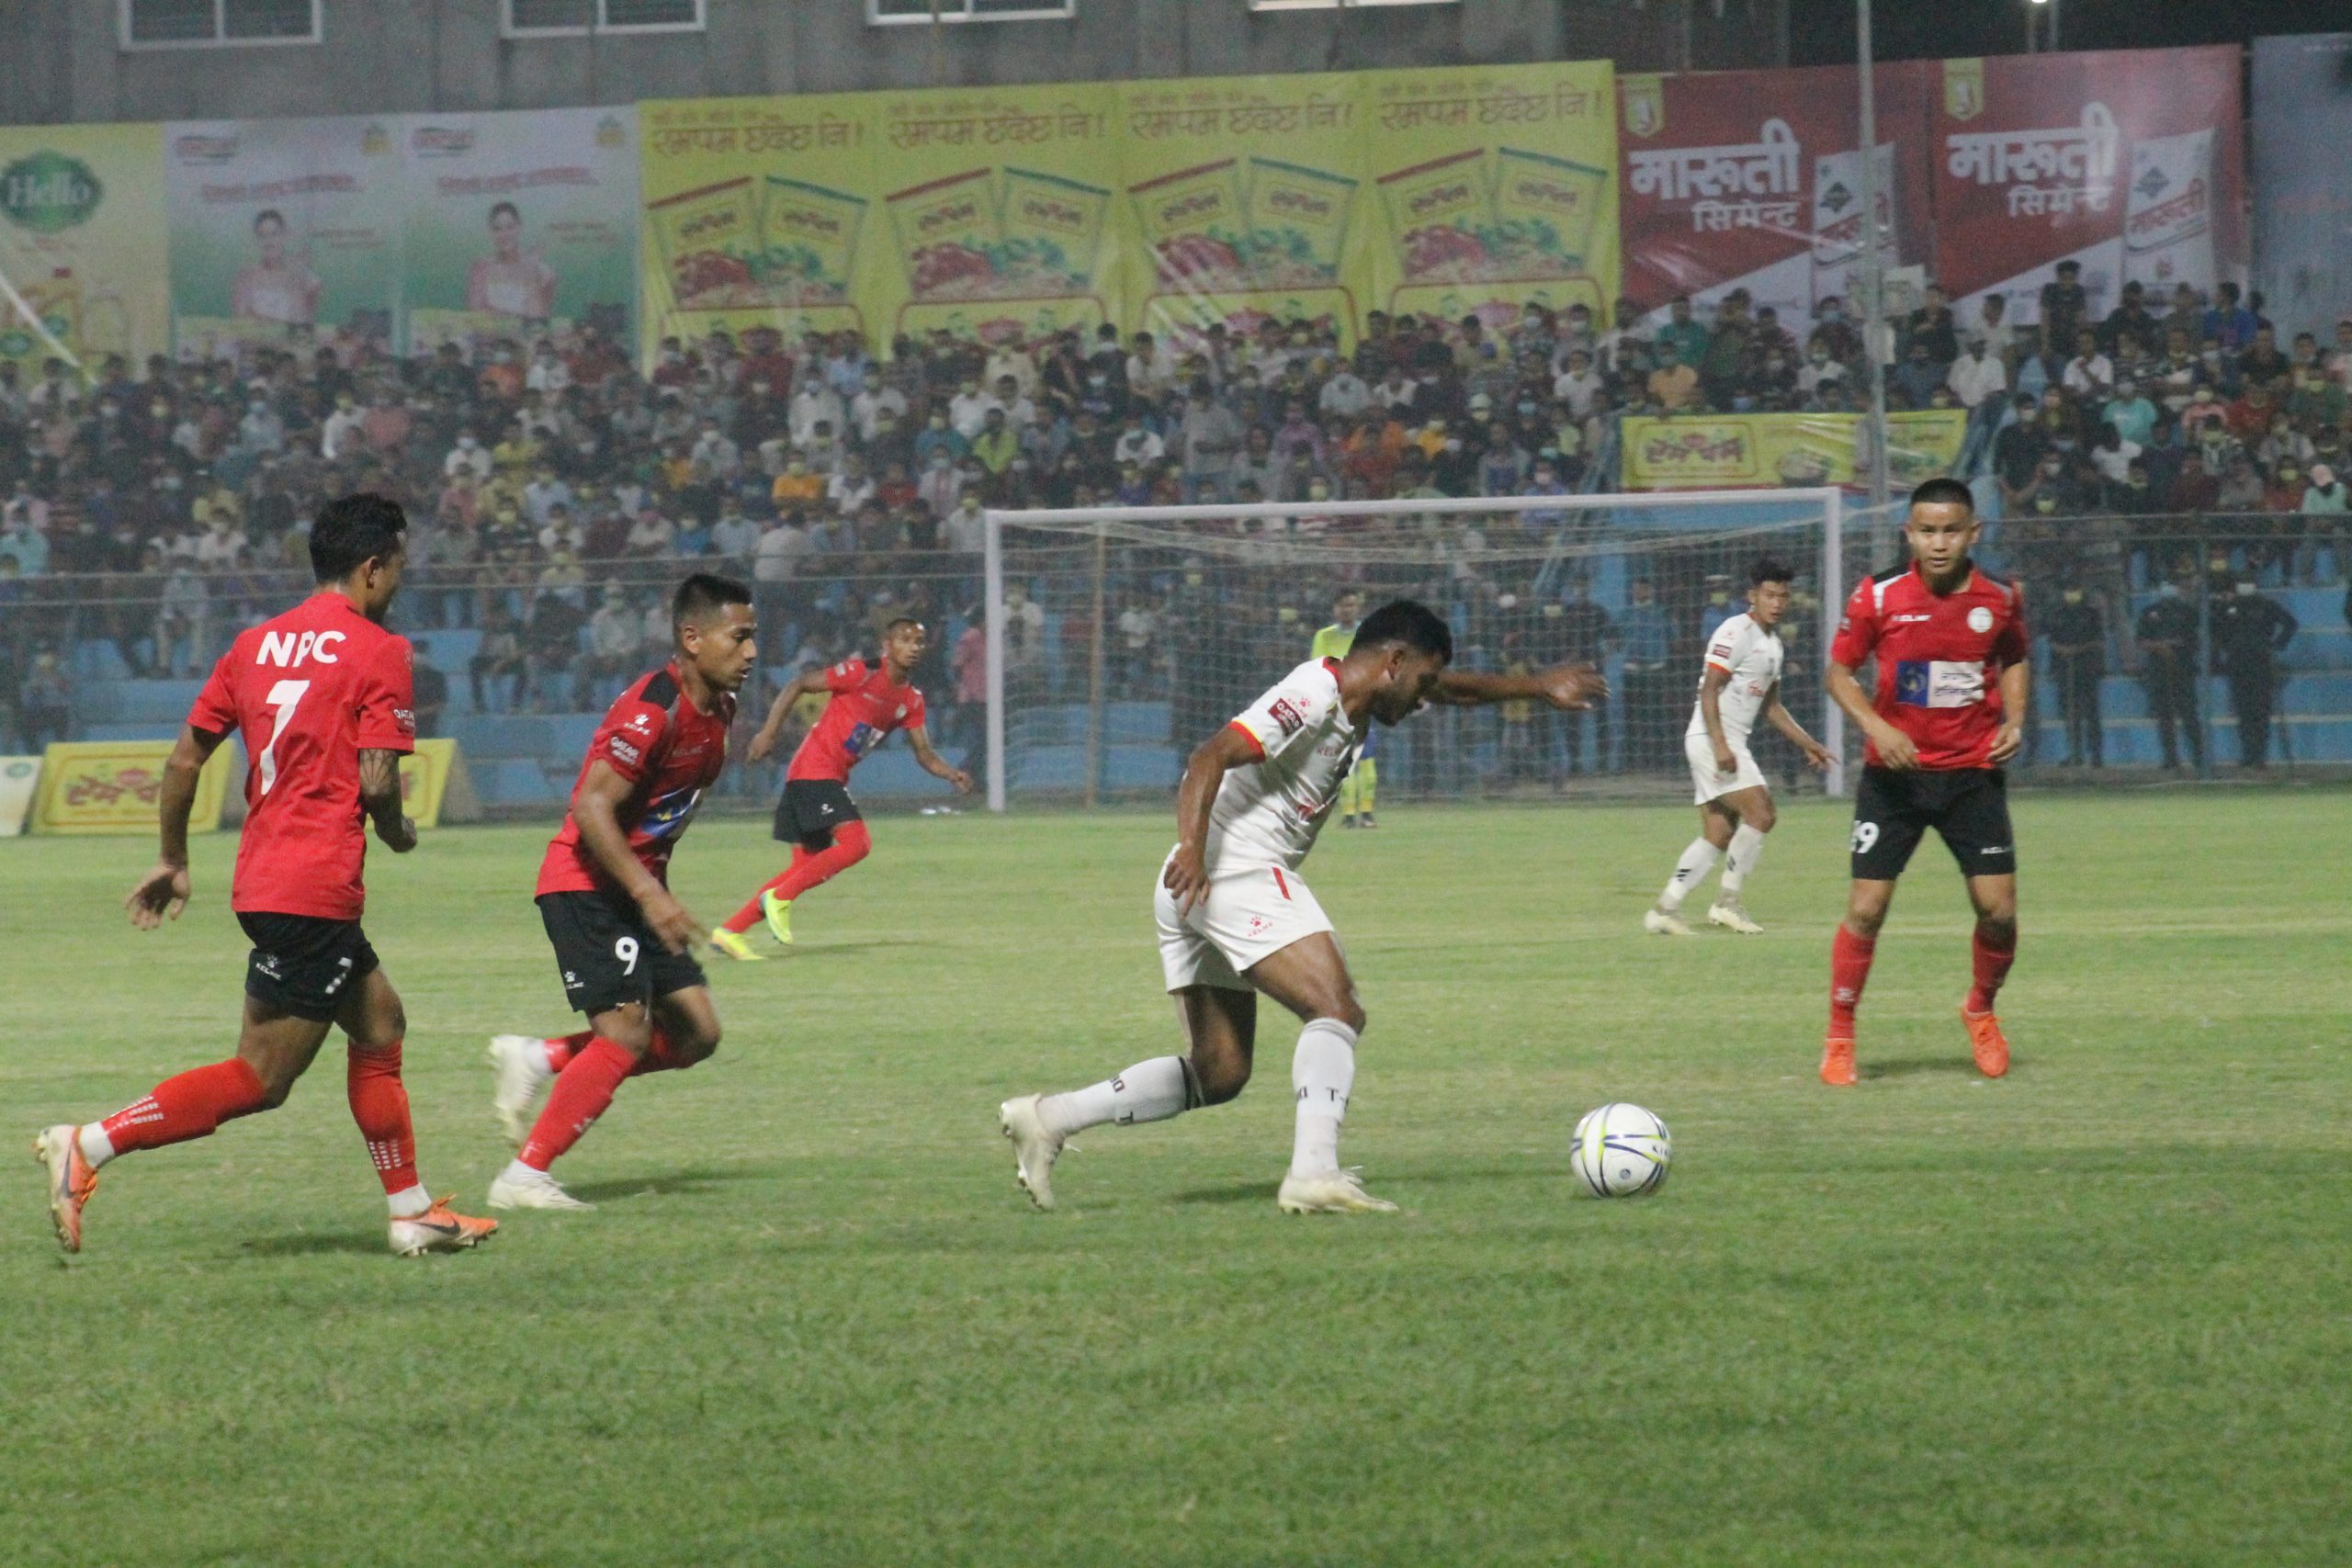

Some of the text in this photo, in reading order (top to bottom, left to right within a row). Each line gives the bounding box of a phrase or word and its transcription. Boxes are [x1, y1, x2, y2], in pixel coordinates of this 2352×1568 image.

[255, 630, 346, 667] NPC
[259, 680, 311, 795] 7
[615, 936, 639, 976] 9
